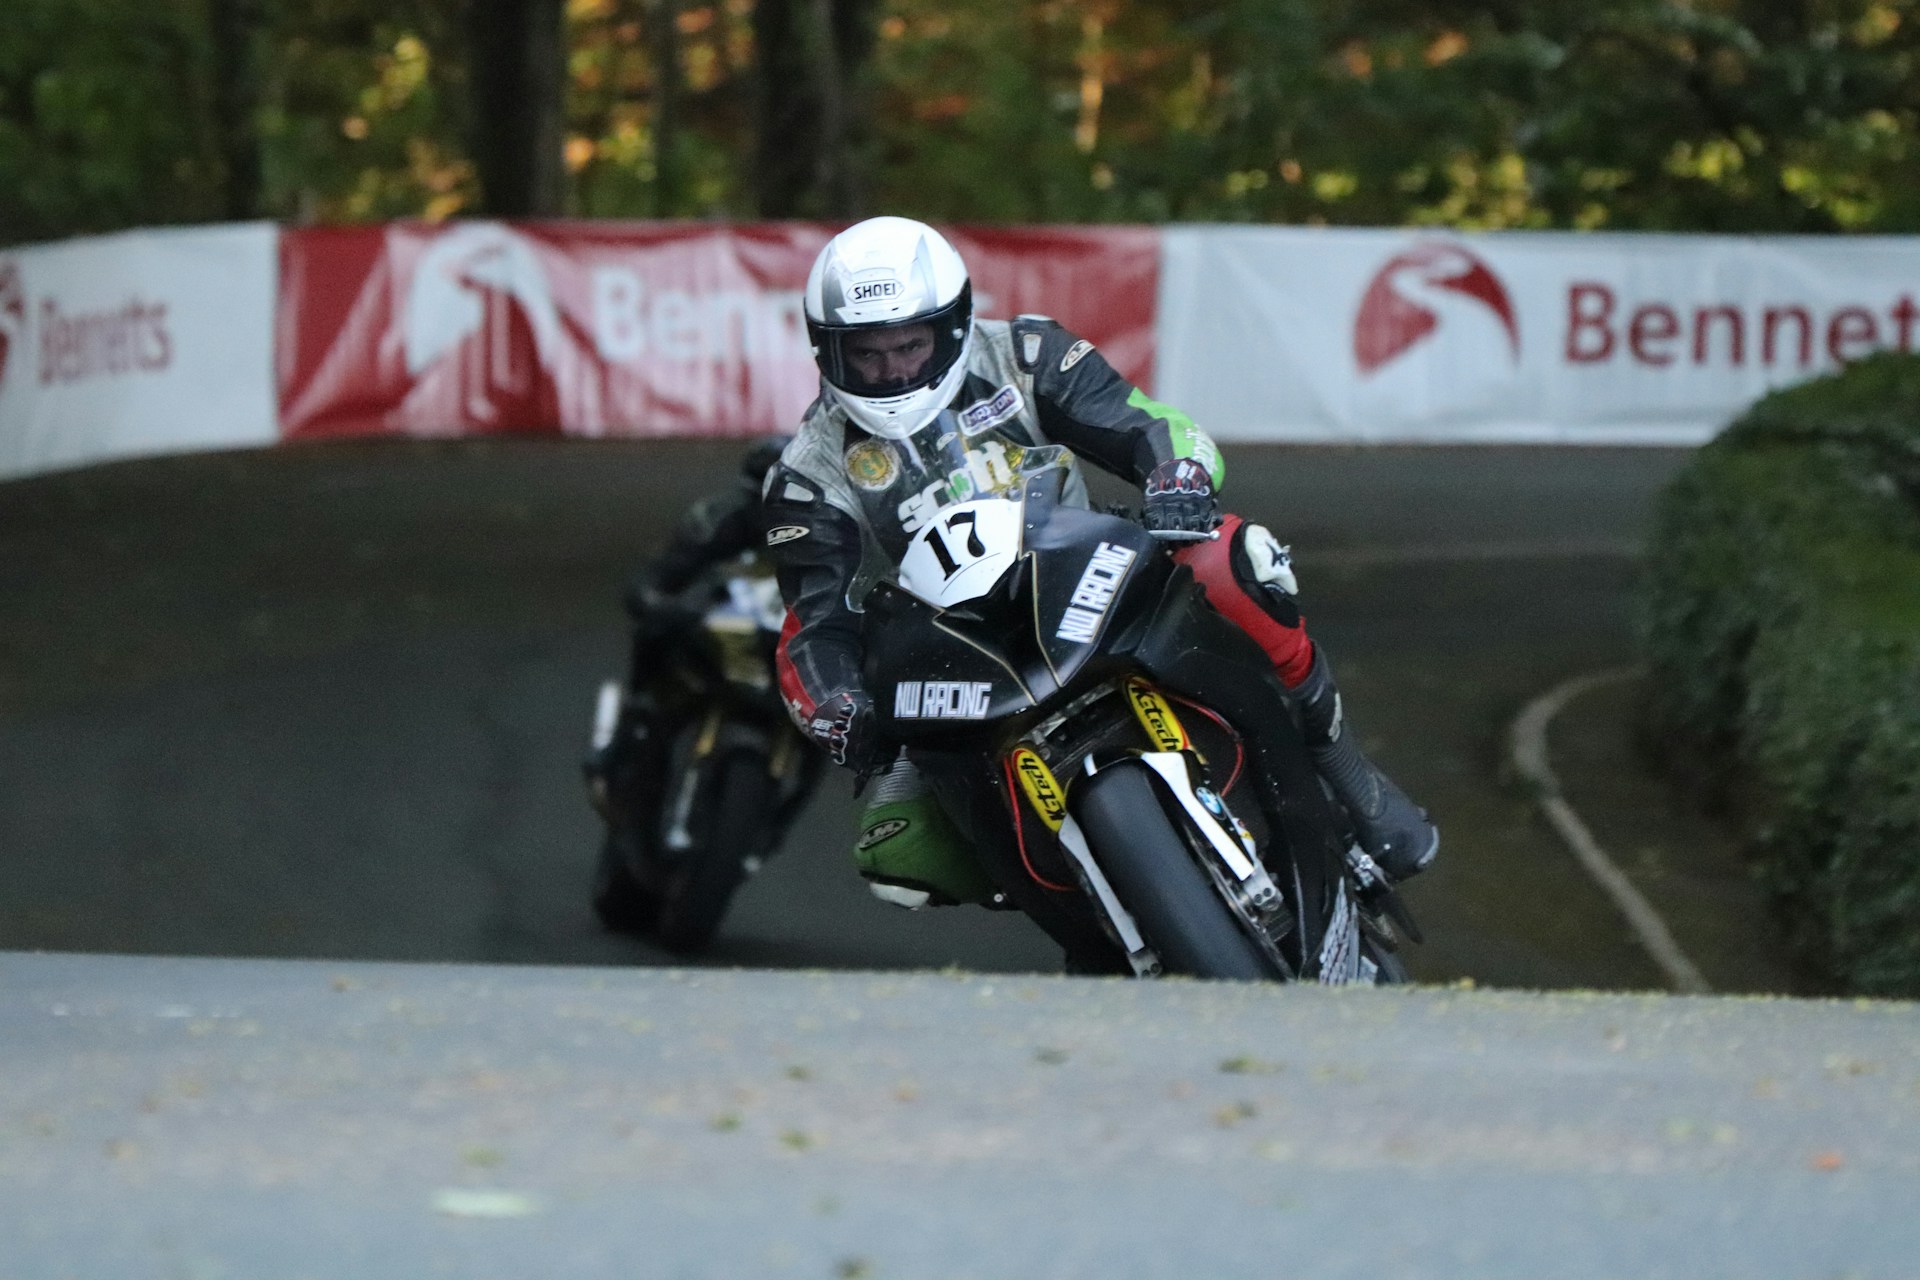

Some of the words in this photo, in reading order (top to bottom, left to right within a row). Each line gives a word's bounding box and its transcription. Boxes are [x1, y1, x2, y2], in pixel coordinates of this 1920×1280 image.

[854, 283, 896, 300] SHOEI
[923, 510, 986, 582] 17
[1070, 541, 1137, 614] RACING
[921, 681, 992, 720] RACING
